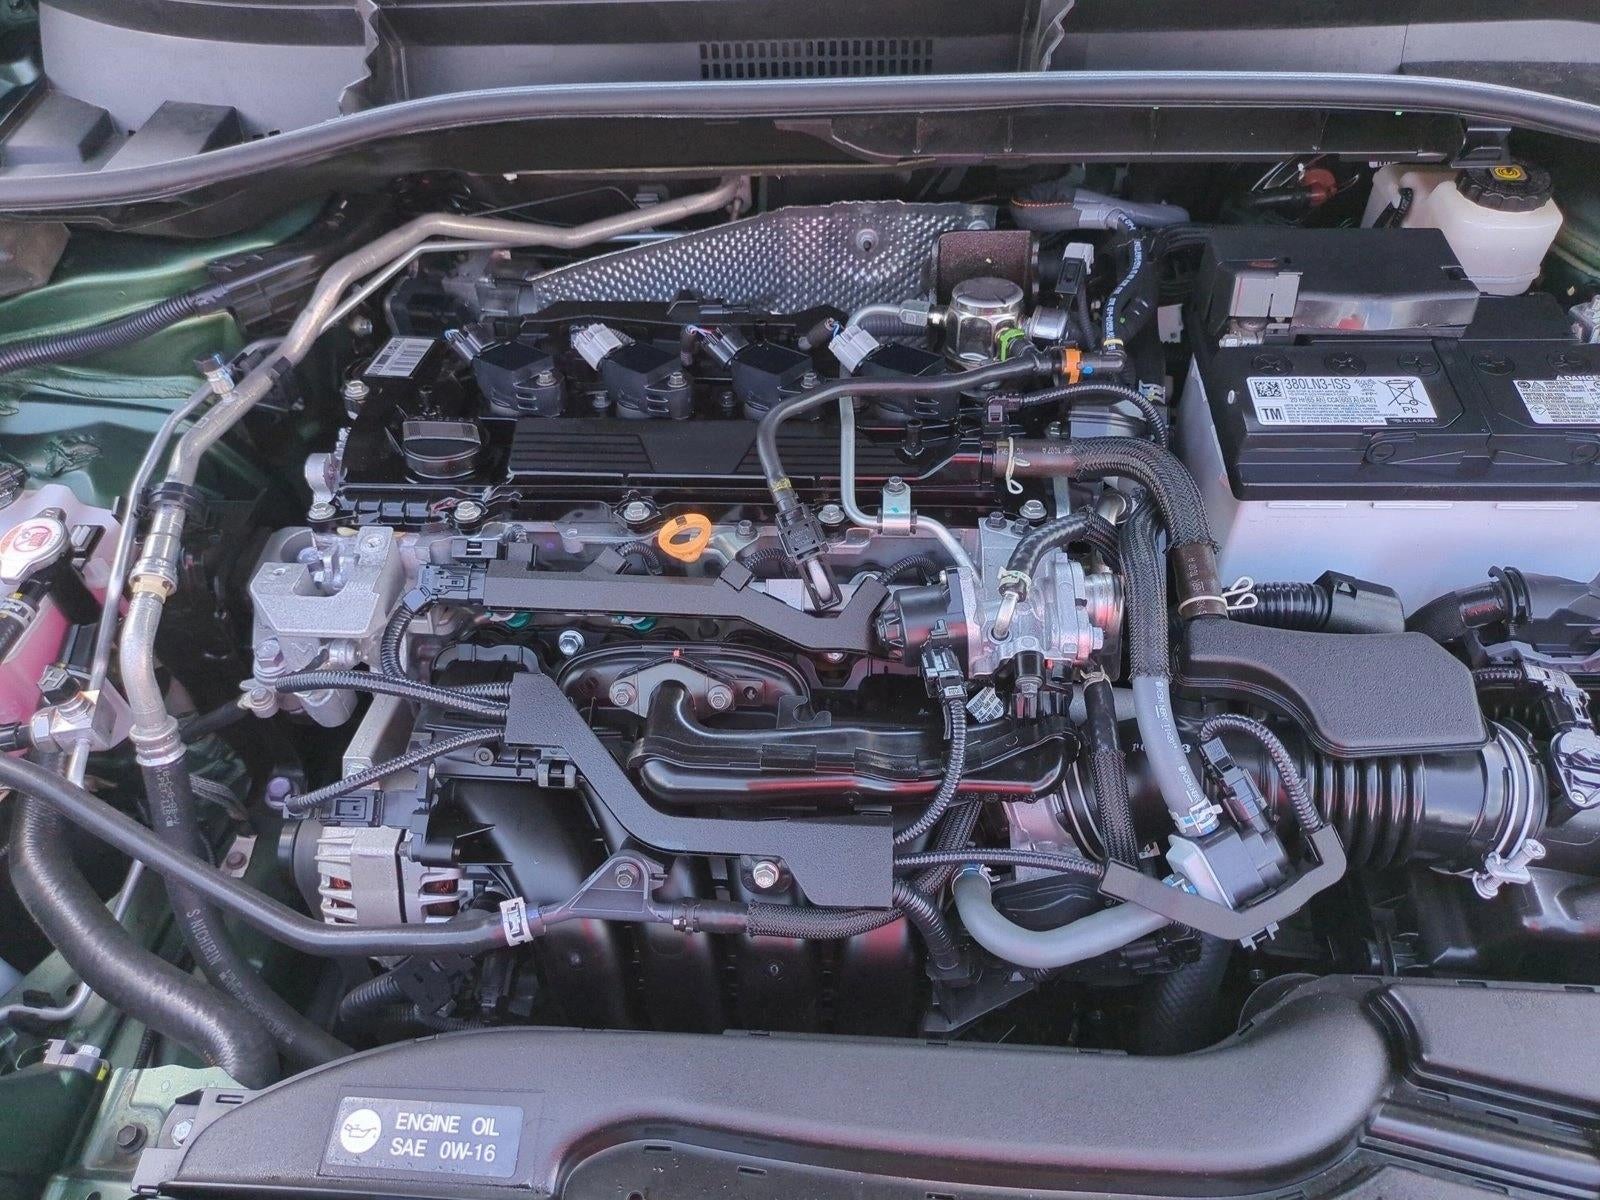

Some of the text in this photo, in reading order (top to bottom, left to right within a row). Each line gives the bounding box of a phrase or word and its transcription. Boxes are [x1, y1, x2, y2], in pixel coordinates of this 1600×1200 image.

[1285, 378, 1351, 390] 380LN3-ISS
[1262, 408, 1283, 420] TM
[395, 1112, 500, 1137] ENGINE OIL
[390, 1138, 496, 1162] SAE 0W-16
